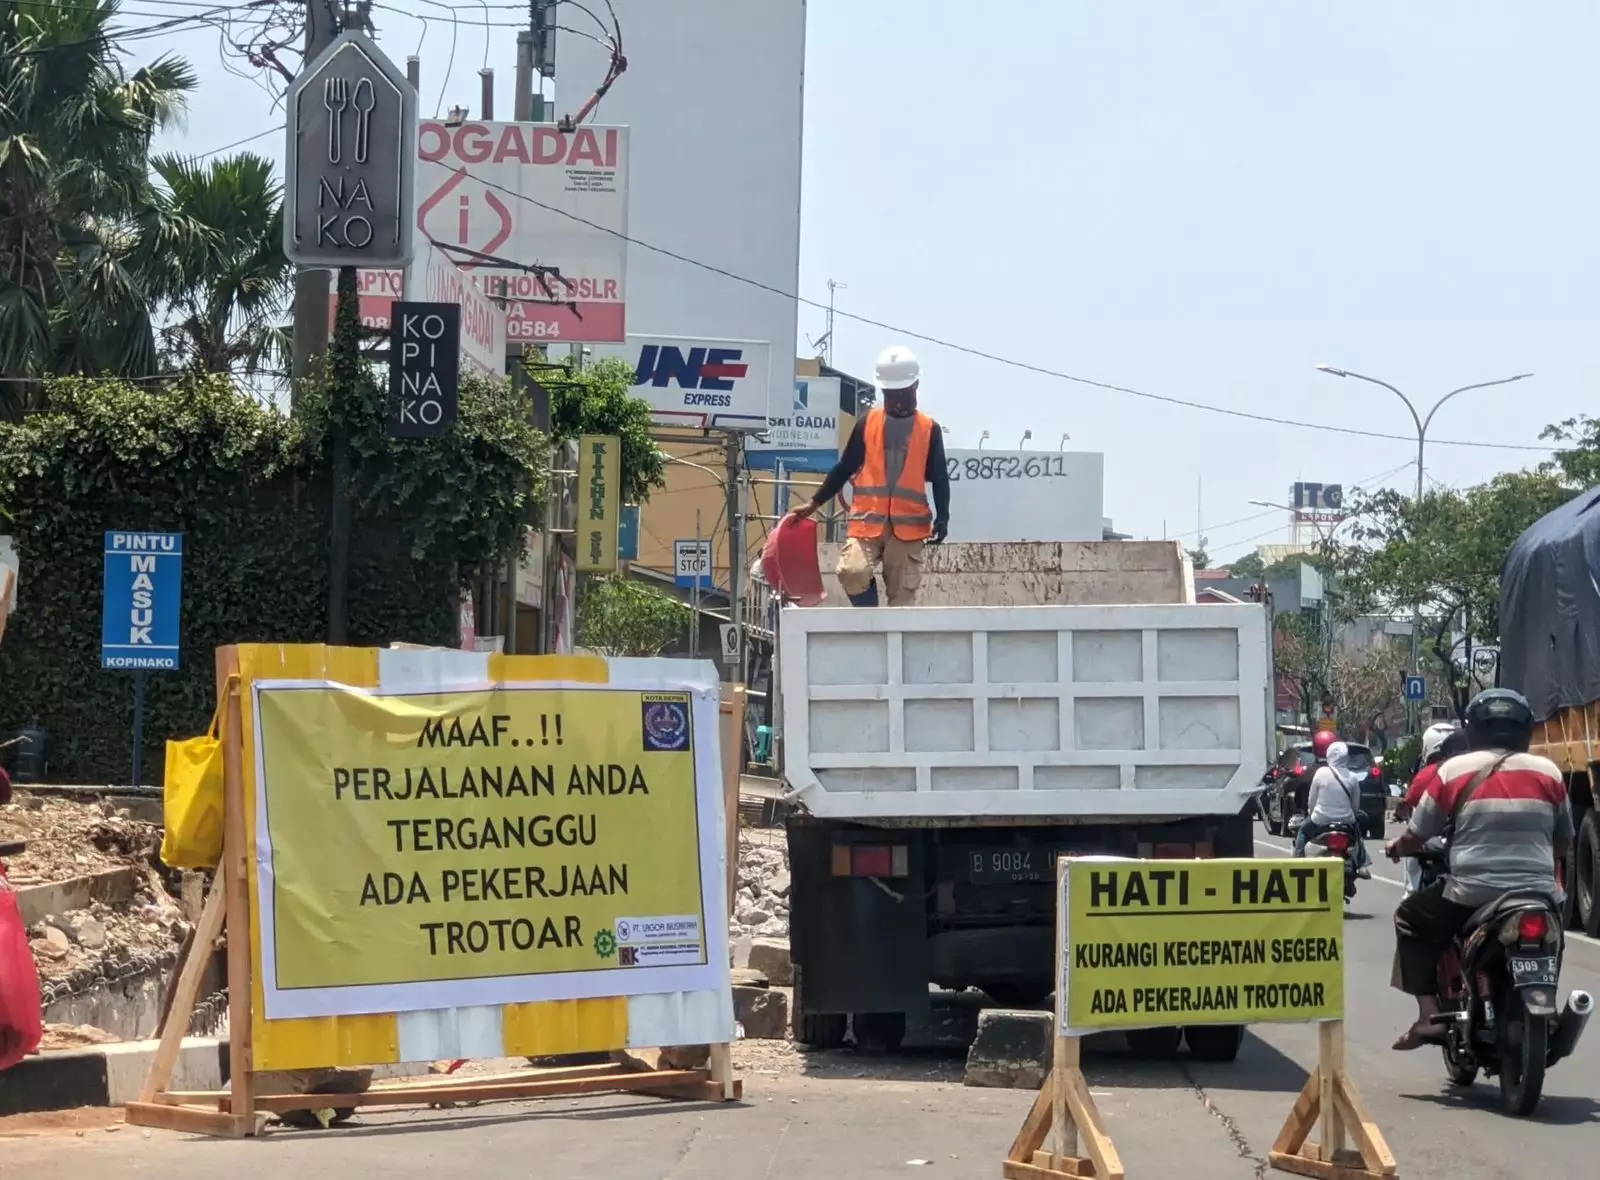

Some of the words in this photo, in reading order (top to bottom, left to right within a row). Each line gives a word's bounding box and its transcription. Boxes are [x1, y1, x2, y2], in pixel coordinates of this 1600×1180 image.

[320, 175, 373, 211] NA
[317, 215, 374, 248] KO
[565, 278, 617, 299] DSLR
[403, 313, 445, 339] KO
[508, 321, 560, 338] 0584
[634, 344, 748, 391] JNE
[402, 373, 442, 397] NA
[400, 401, 443, 426] KO
[683, 392, 732, 408] EXPRESS
[795, 415, 836, 430] GADAI
[1294, 481, 1342, 509] ITC
[112, 533, 175, 551] PINTU
[680, 558, 707, 573] STOP
[130, 555, 156, 645] MASUK
[106, 656, 174, 668] KOPINAKO
[333, 764, 556, 801] PERJALANAN
[566, 763, 650, 797] ANDA
[387, 814, 597, 853] TERGANGGU
[992, 852, 1032, 872] 9084
[359, 871, 431, 907] ADA
[442, 863, 629, 903] PEKERJAAN
[1090, 870, 1190, 908] HATI
[1231, 867, 1328, 905] HATI
[420, 915, 584, 956] TROTOAR
[1075, 942, 1158, 970] KURANGI
[1163, 939, 1266, 967] KECEPATAN
[1270, 937, 1340, 964] SEGERA
[1090, 988, 1128, 1015] ADA
[1133, 984, 1239, 1013] PEKERJAAN
[1243, 982, 1325, 1010] TROTOAR
